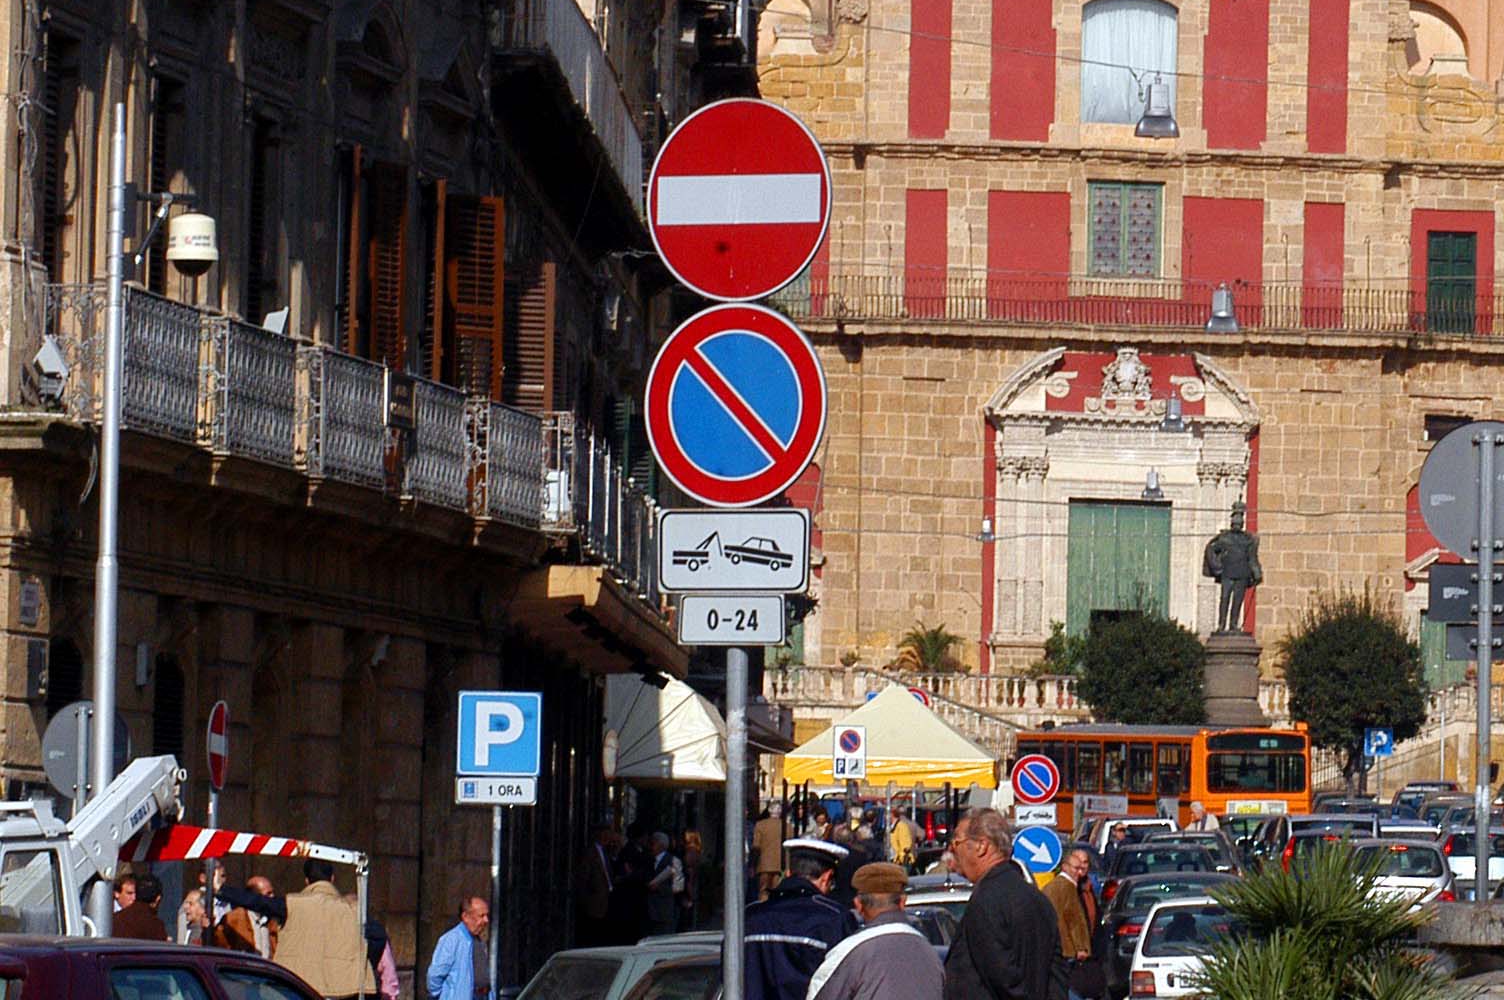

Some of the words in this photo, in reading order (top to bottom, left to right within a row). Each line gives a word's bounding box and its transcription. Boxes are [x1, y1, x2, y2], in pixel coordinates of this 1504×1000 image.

[707, 608, 759, 631] 0-24
[474, 701, 525, 767] P
[489, 785, 494, 796] 1
[498, 785, 523, 796] ORA
